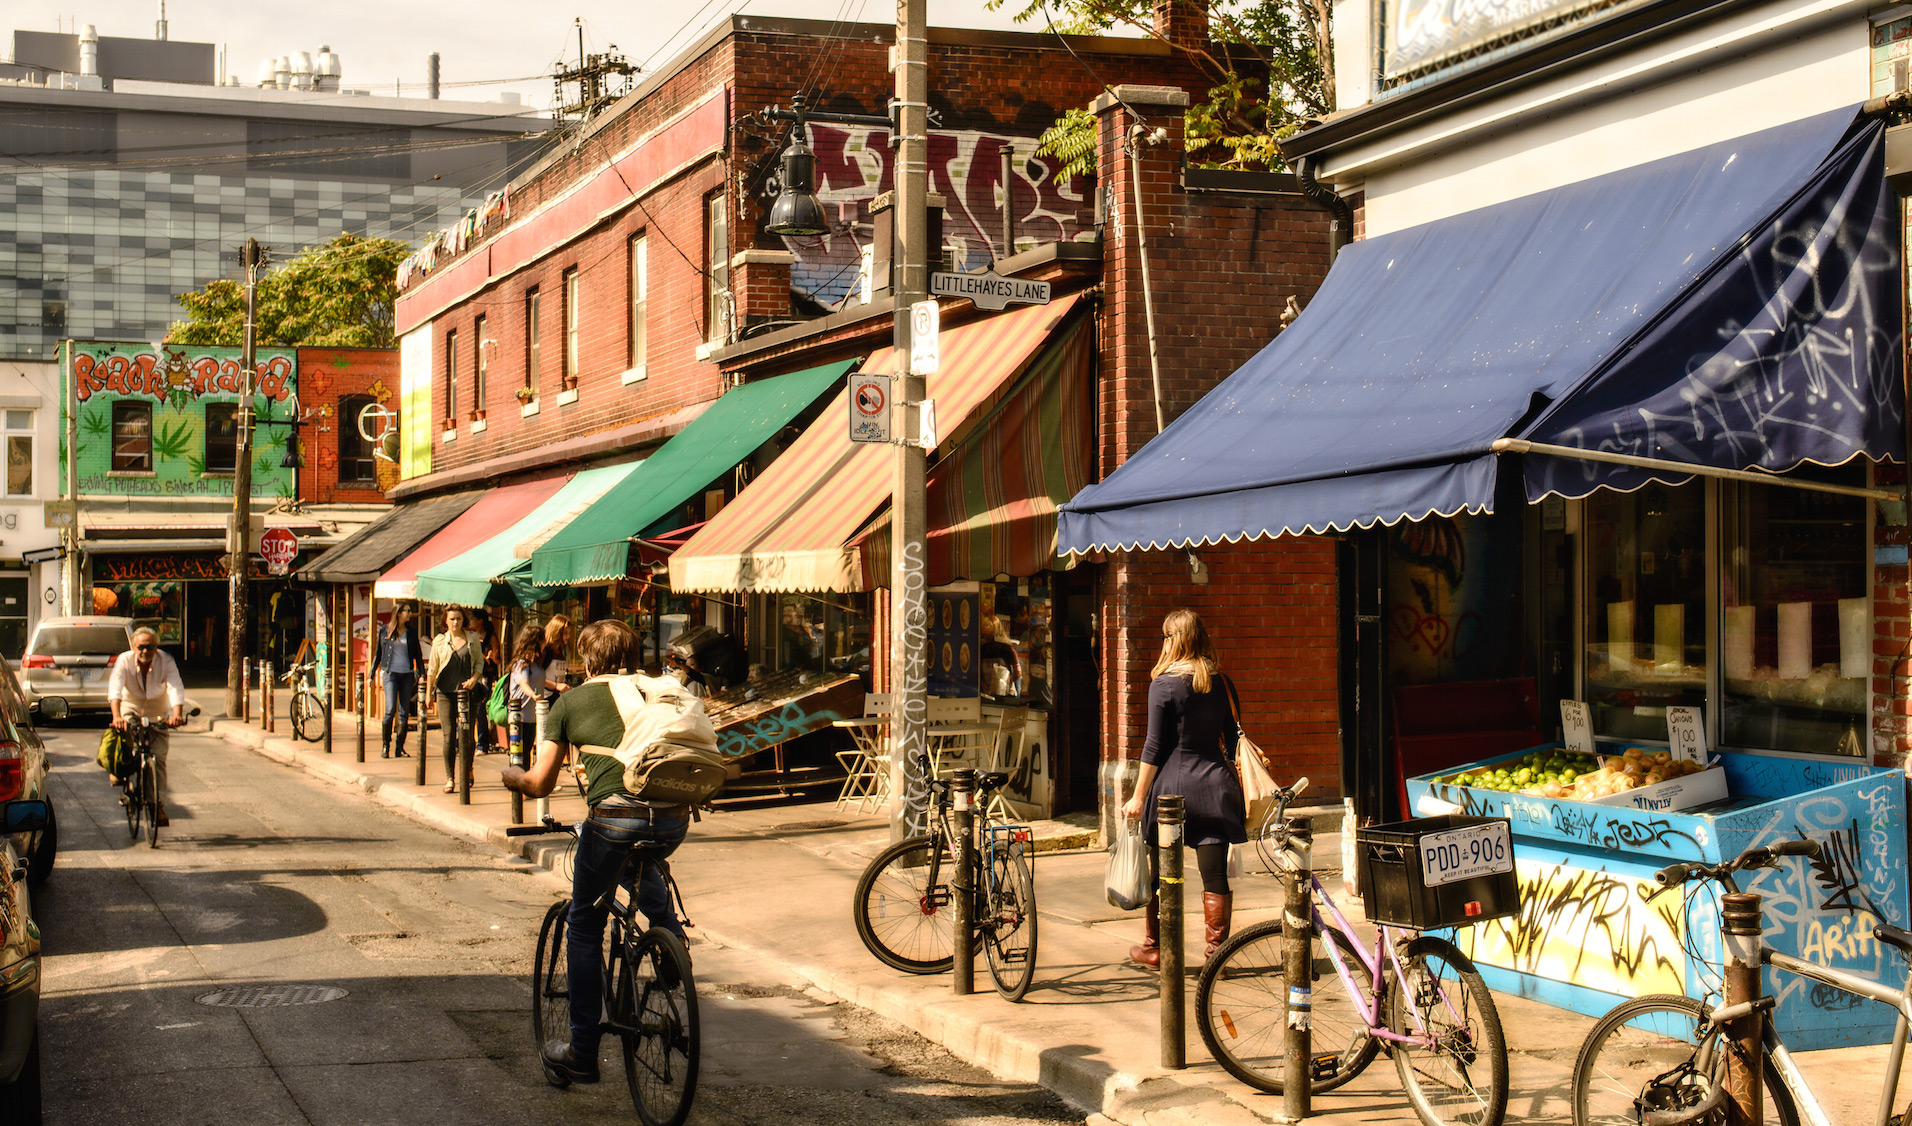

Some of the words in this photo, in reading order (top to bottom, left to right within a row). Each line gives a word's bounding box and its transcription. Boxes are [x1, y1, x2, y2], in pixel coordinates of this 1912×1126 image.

[934, 275, 1013, 297] LITTLEHAYES
[1015, 282, 1047, 300] LANE
[262, 538, 296, 554] STOP
[1562, 700, 1582, 709] LIMES
[651, 776, 697, 792] adidas
[1446, 830, 1481, 843] ONTARIO
[1426, 844, 1460, 874] PDD
[1470, 835, 1504, 865] 906
[1464, 865, 1491, 875] BEAUTIFUL
